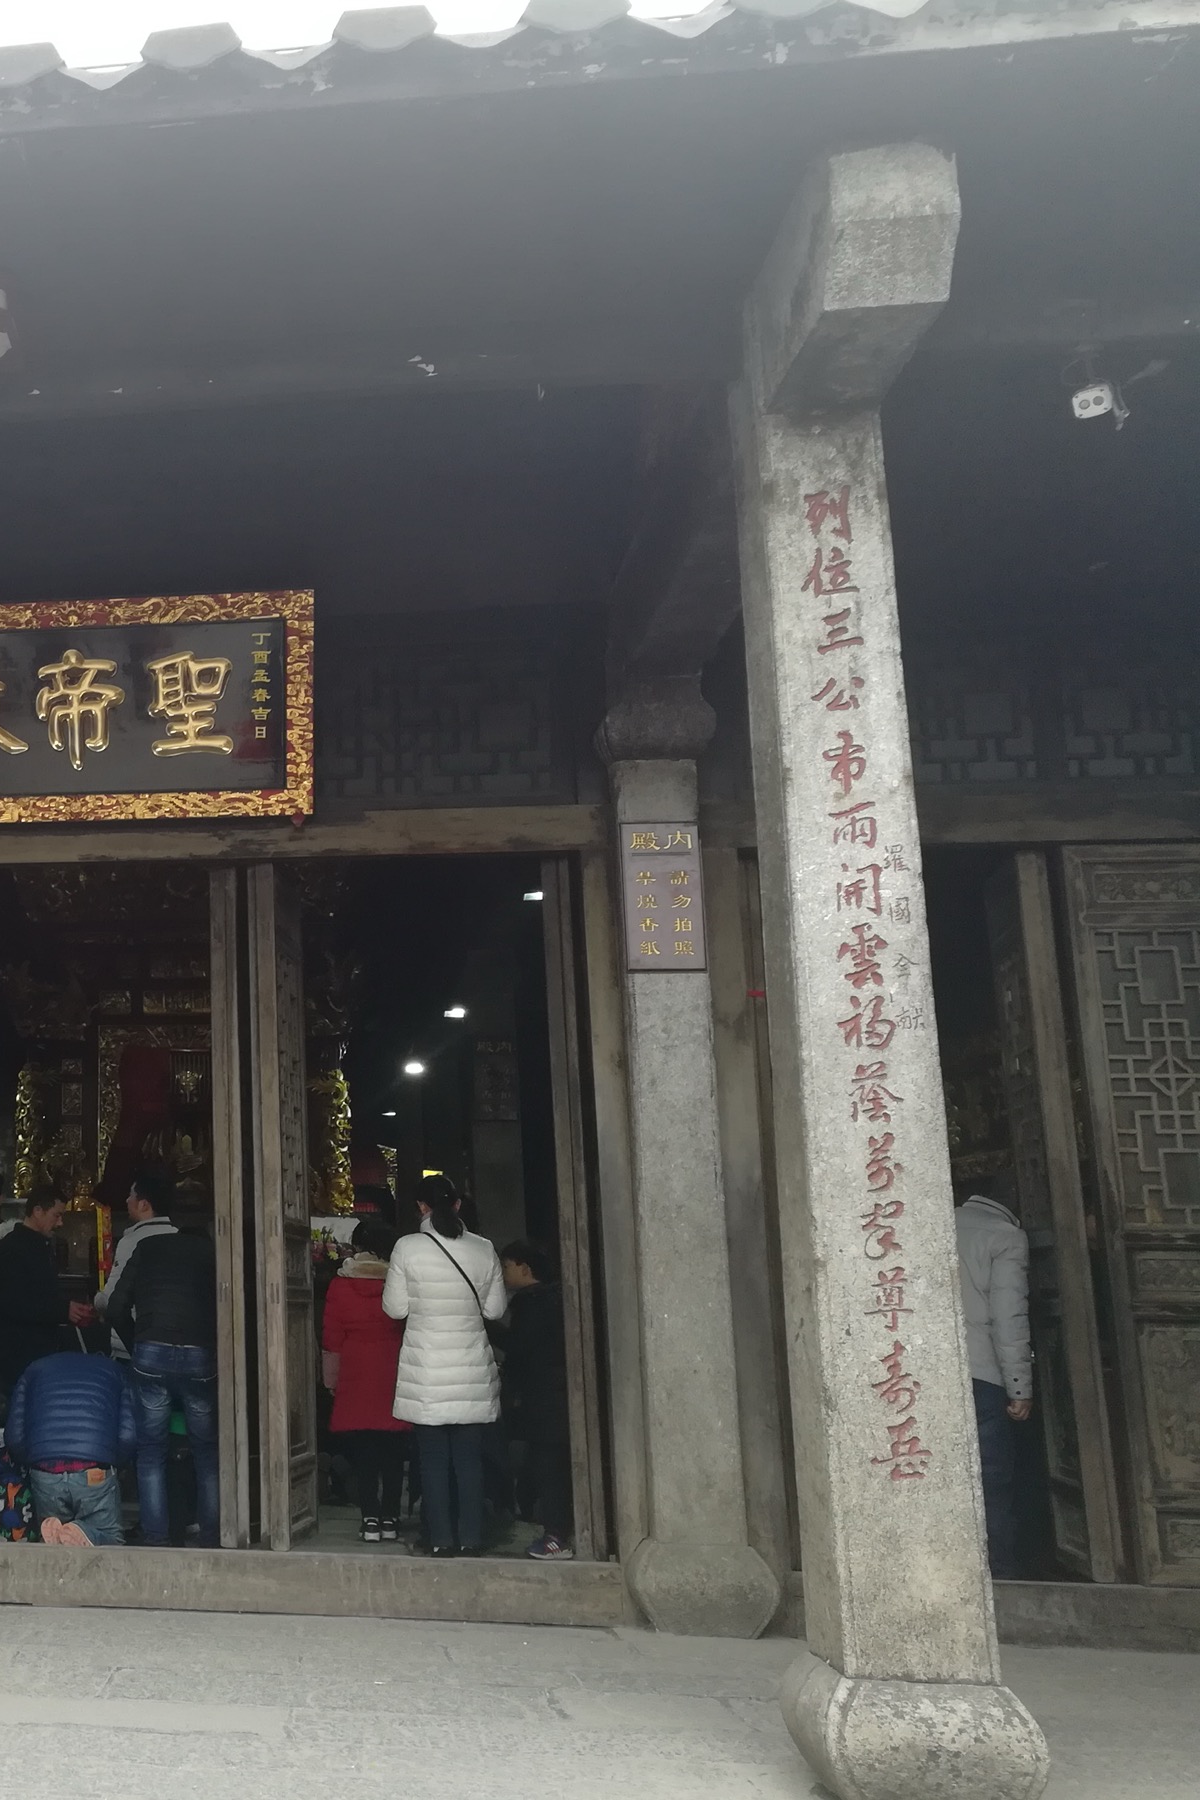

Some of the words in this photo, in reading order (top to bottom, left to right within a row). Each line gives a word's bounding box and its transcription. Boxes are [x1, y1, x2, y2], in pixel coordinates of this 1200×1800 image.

[250, 632, 272, 739] 丁酉孟春吉日
